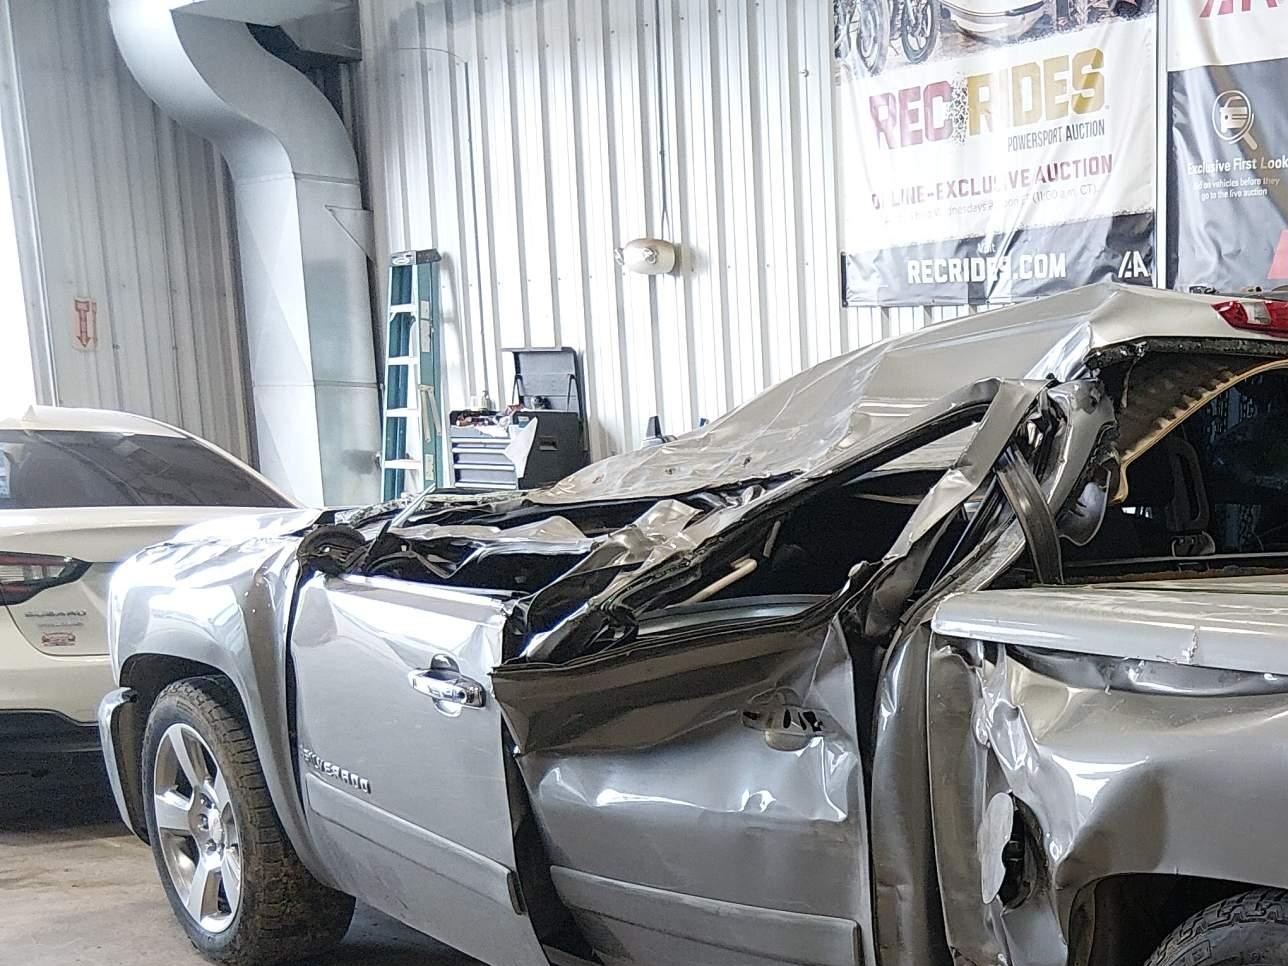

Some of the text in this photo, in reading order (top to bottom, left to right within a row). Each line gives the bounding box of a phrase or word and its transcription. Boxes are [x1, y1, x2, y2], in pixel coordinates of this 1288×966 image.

[869, 80, 954, 150] REC
[1007, 118, 1105, 153] POWERSPORT AUCTION
[1187, 154, 1288, 176] Exclusive First Look
[871, 154, 1113, 211] OLINE-EXCLUVE AUCTION
[1201, 187, 1268, 201] go to the live auction
[1203, 181, 1212, 189] on
[1212, 178, 1239, 189] vehicles
[1240, 176, 1262, 187] before
[1263, 176, 1280, 187] they
[907, 252, 1067, 285] RECRIDES.COM
